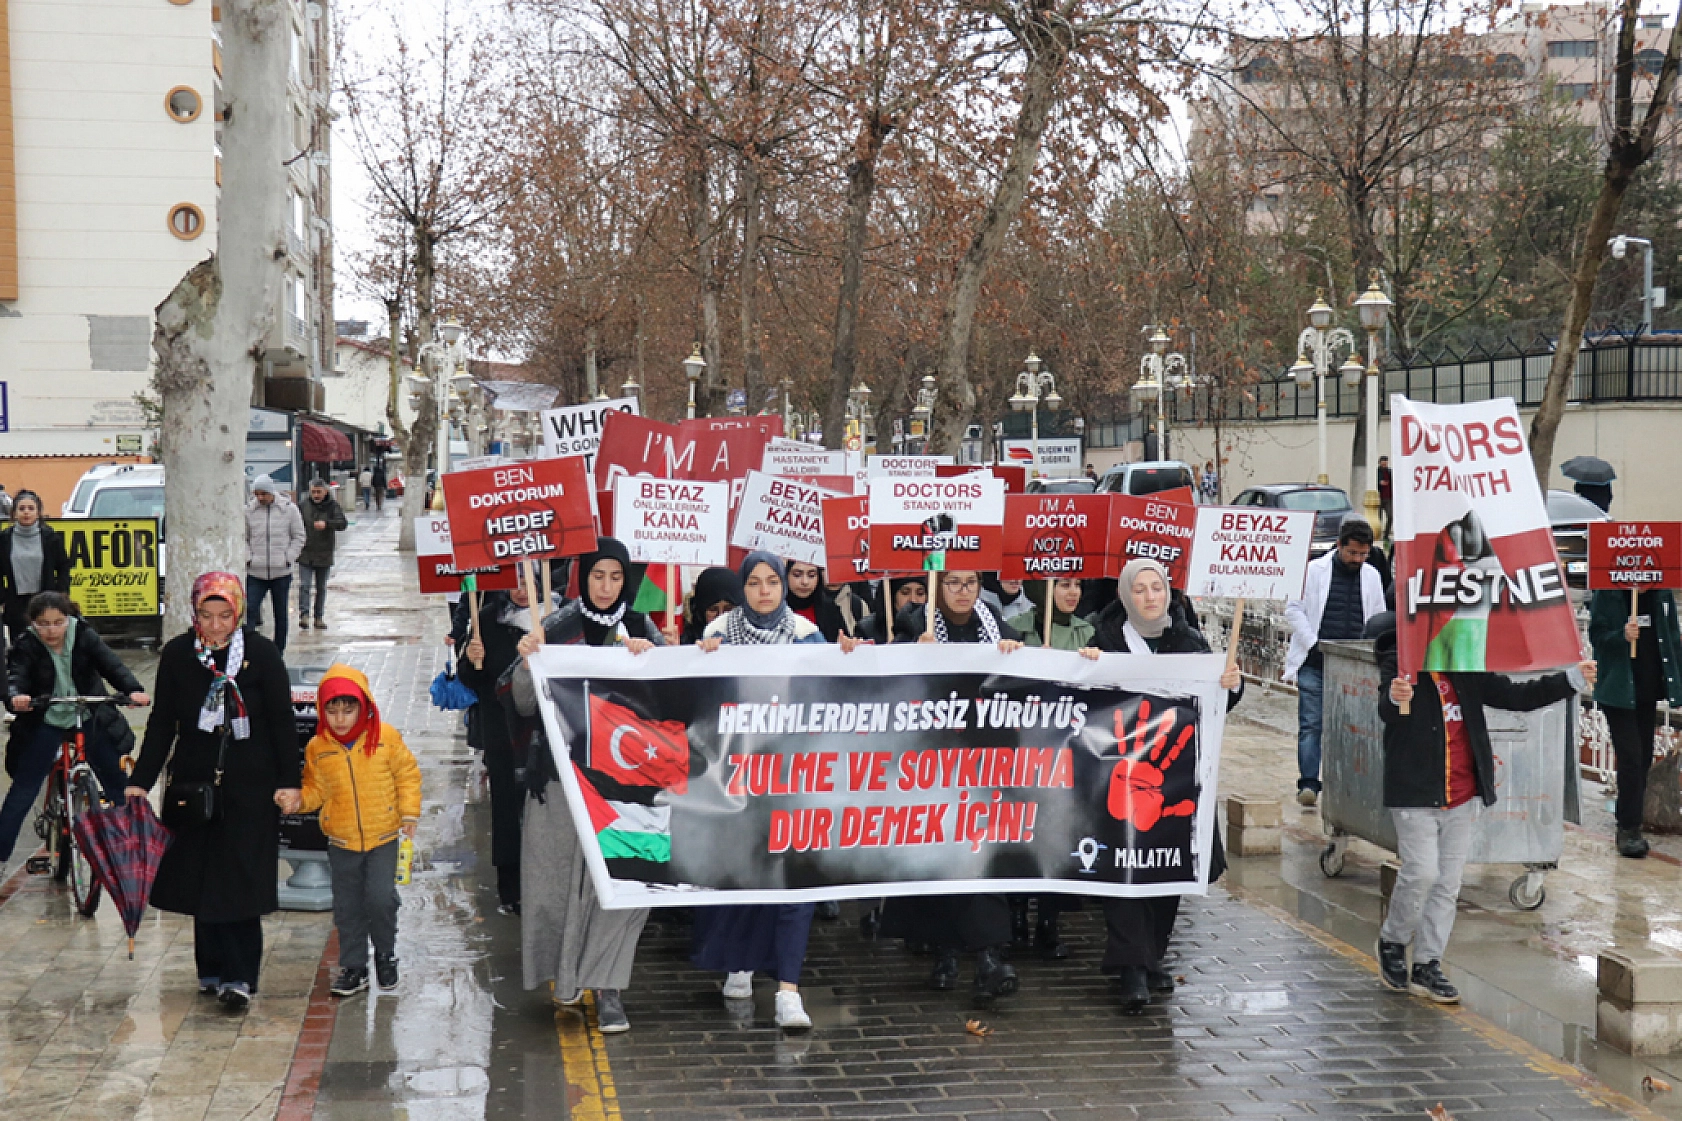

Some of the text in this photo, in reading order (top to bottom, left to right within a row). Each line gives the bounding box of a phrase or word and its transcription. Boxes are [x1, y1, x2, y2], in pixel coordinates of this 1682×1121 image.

[711, 440, 730, 472] A
[773, 455, 830, 464] HASTANEYE
[882, 459, 938, 469] DOCTORS
[493, 467, 534, 488] BEN
[470, 484, 564, 509] DOKTORUM
[641, 482, 704, 502] BEYAZ
[893, 483, 982, 498] DOCTORS
[903, 501, 972, 511] STAND WITH
[1039, 498, 1076, 511] I'M A
[1145, 502, 1178, 521] BEN
[486, 510, 555, 535] HEDEF
[643, 511, 699, 530] KANA
[766, 507, 821, 533] KANA
[1026, 514, 1087, 528] DOCTOR
[1120, 516, 1194, 538] DOKTORUM
[1220, 513, 1289, 533] BEYAZ
[1618, 525, 1651, 534] I'M A
[62, 522, 155, 569] AFÖR
[493, 532, 555, 557] DEĞİL
[634, 530, 707, 543] BULANMASIN
[893, 535, 981, 550] PALESTINE
[1033, 537, 1075, 552] NOT A
[1608, 536, 1663, 548] DOCTOR
[1126, 539, 1181, 561] HEDEF
[1219, 543, 1279, 563] KANA
[1023, 556, 1083, 573] TARGET!
[1209, 563, 1286, 577] BULANMASIN
[1616, 555, 1654, 566] NOT A
[1609, 571, 1663, 582] TARGET!
[718, 691, 1088, 736] HEKİMLERDEN SESSİZ YÜRÜYÜŞ
[726, 747, 1075, 796] ZULME VE SOYKIRIMA
[768, 789, 1038, 853] DUR DEMEK İÇİN!
[1114, 847, 1182, 869] MALATYA
